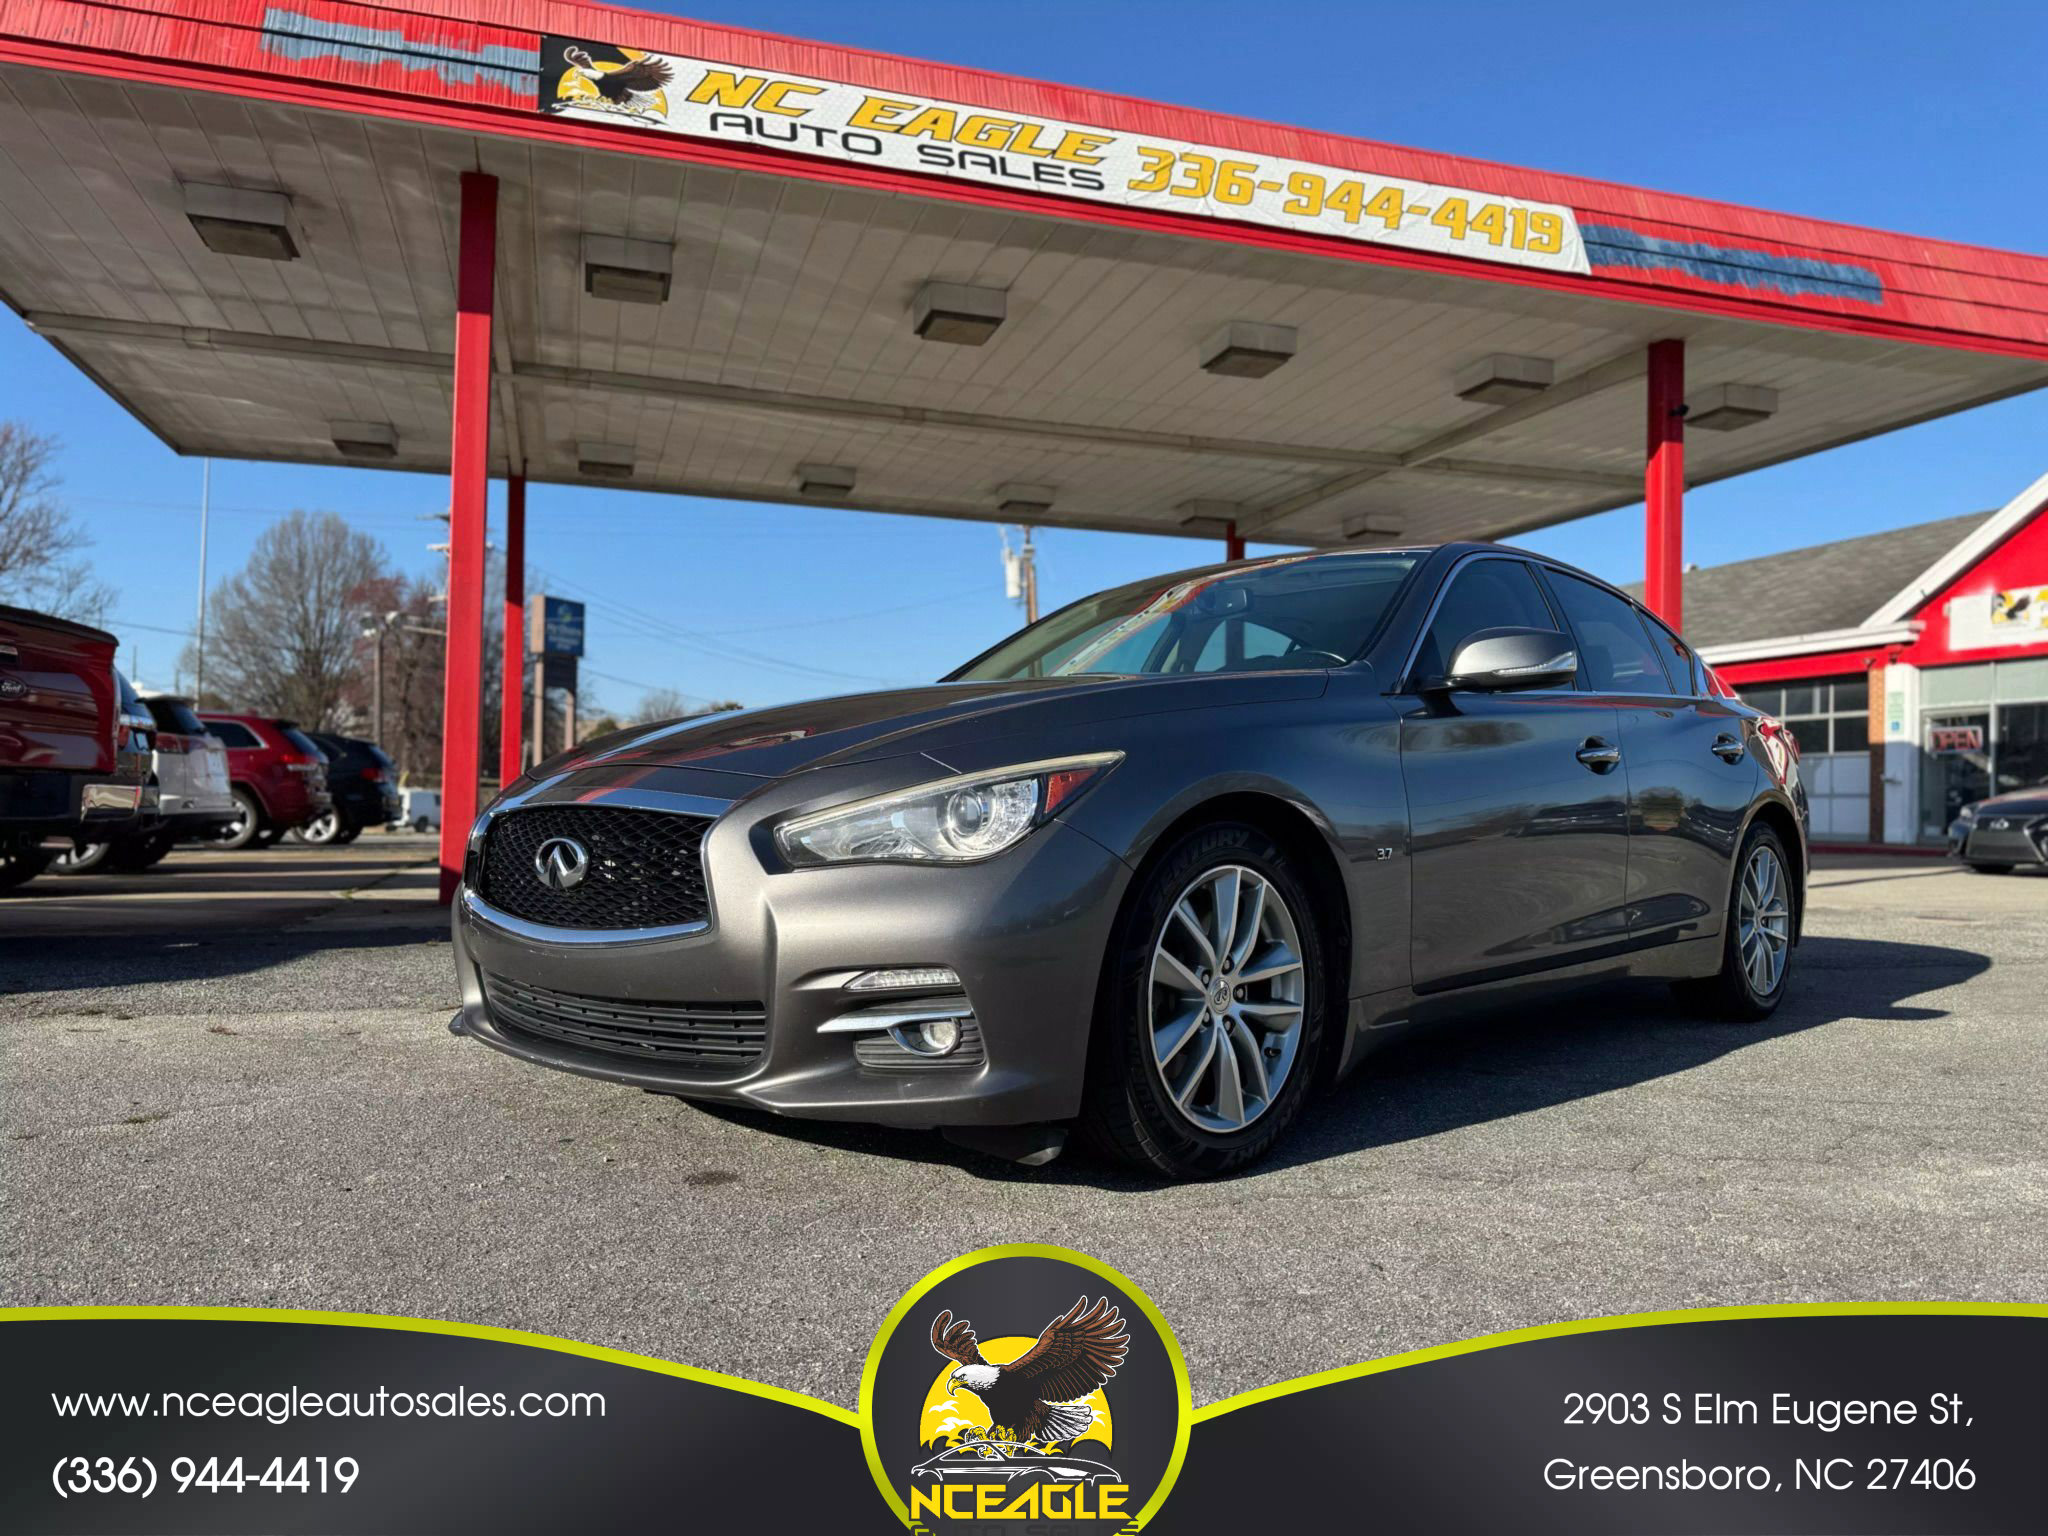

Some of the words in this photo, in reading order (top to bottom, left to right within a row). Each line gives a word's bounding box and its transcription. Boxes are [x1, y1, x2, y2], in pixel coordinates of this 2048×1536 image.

[685, 69, 829, 118] NC
[847, 94, 1117, 166] EAGLE
[709, 111, 883, 157] AUTO
[917, 143, 1105, 192] SALES
[1128, 145, 1564, 256] 336-944-4419
[1931, 727, 1980, 751] OPEN
